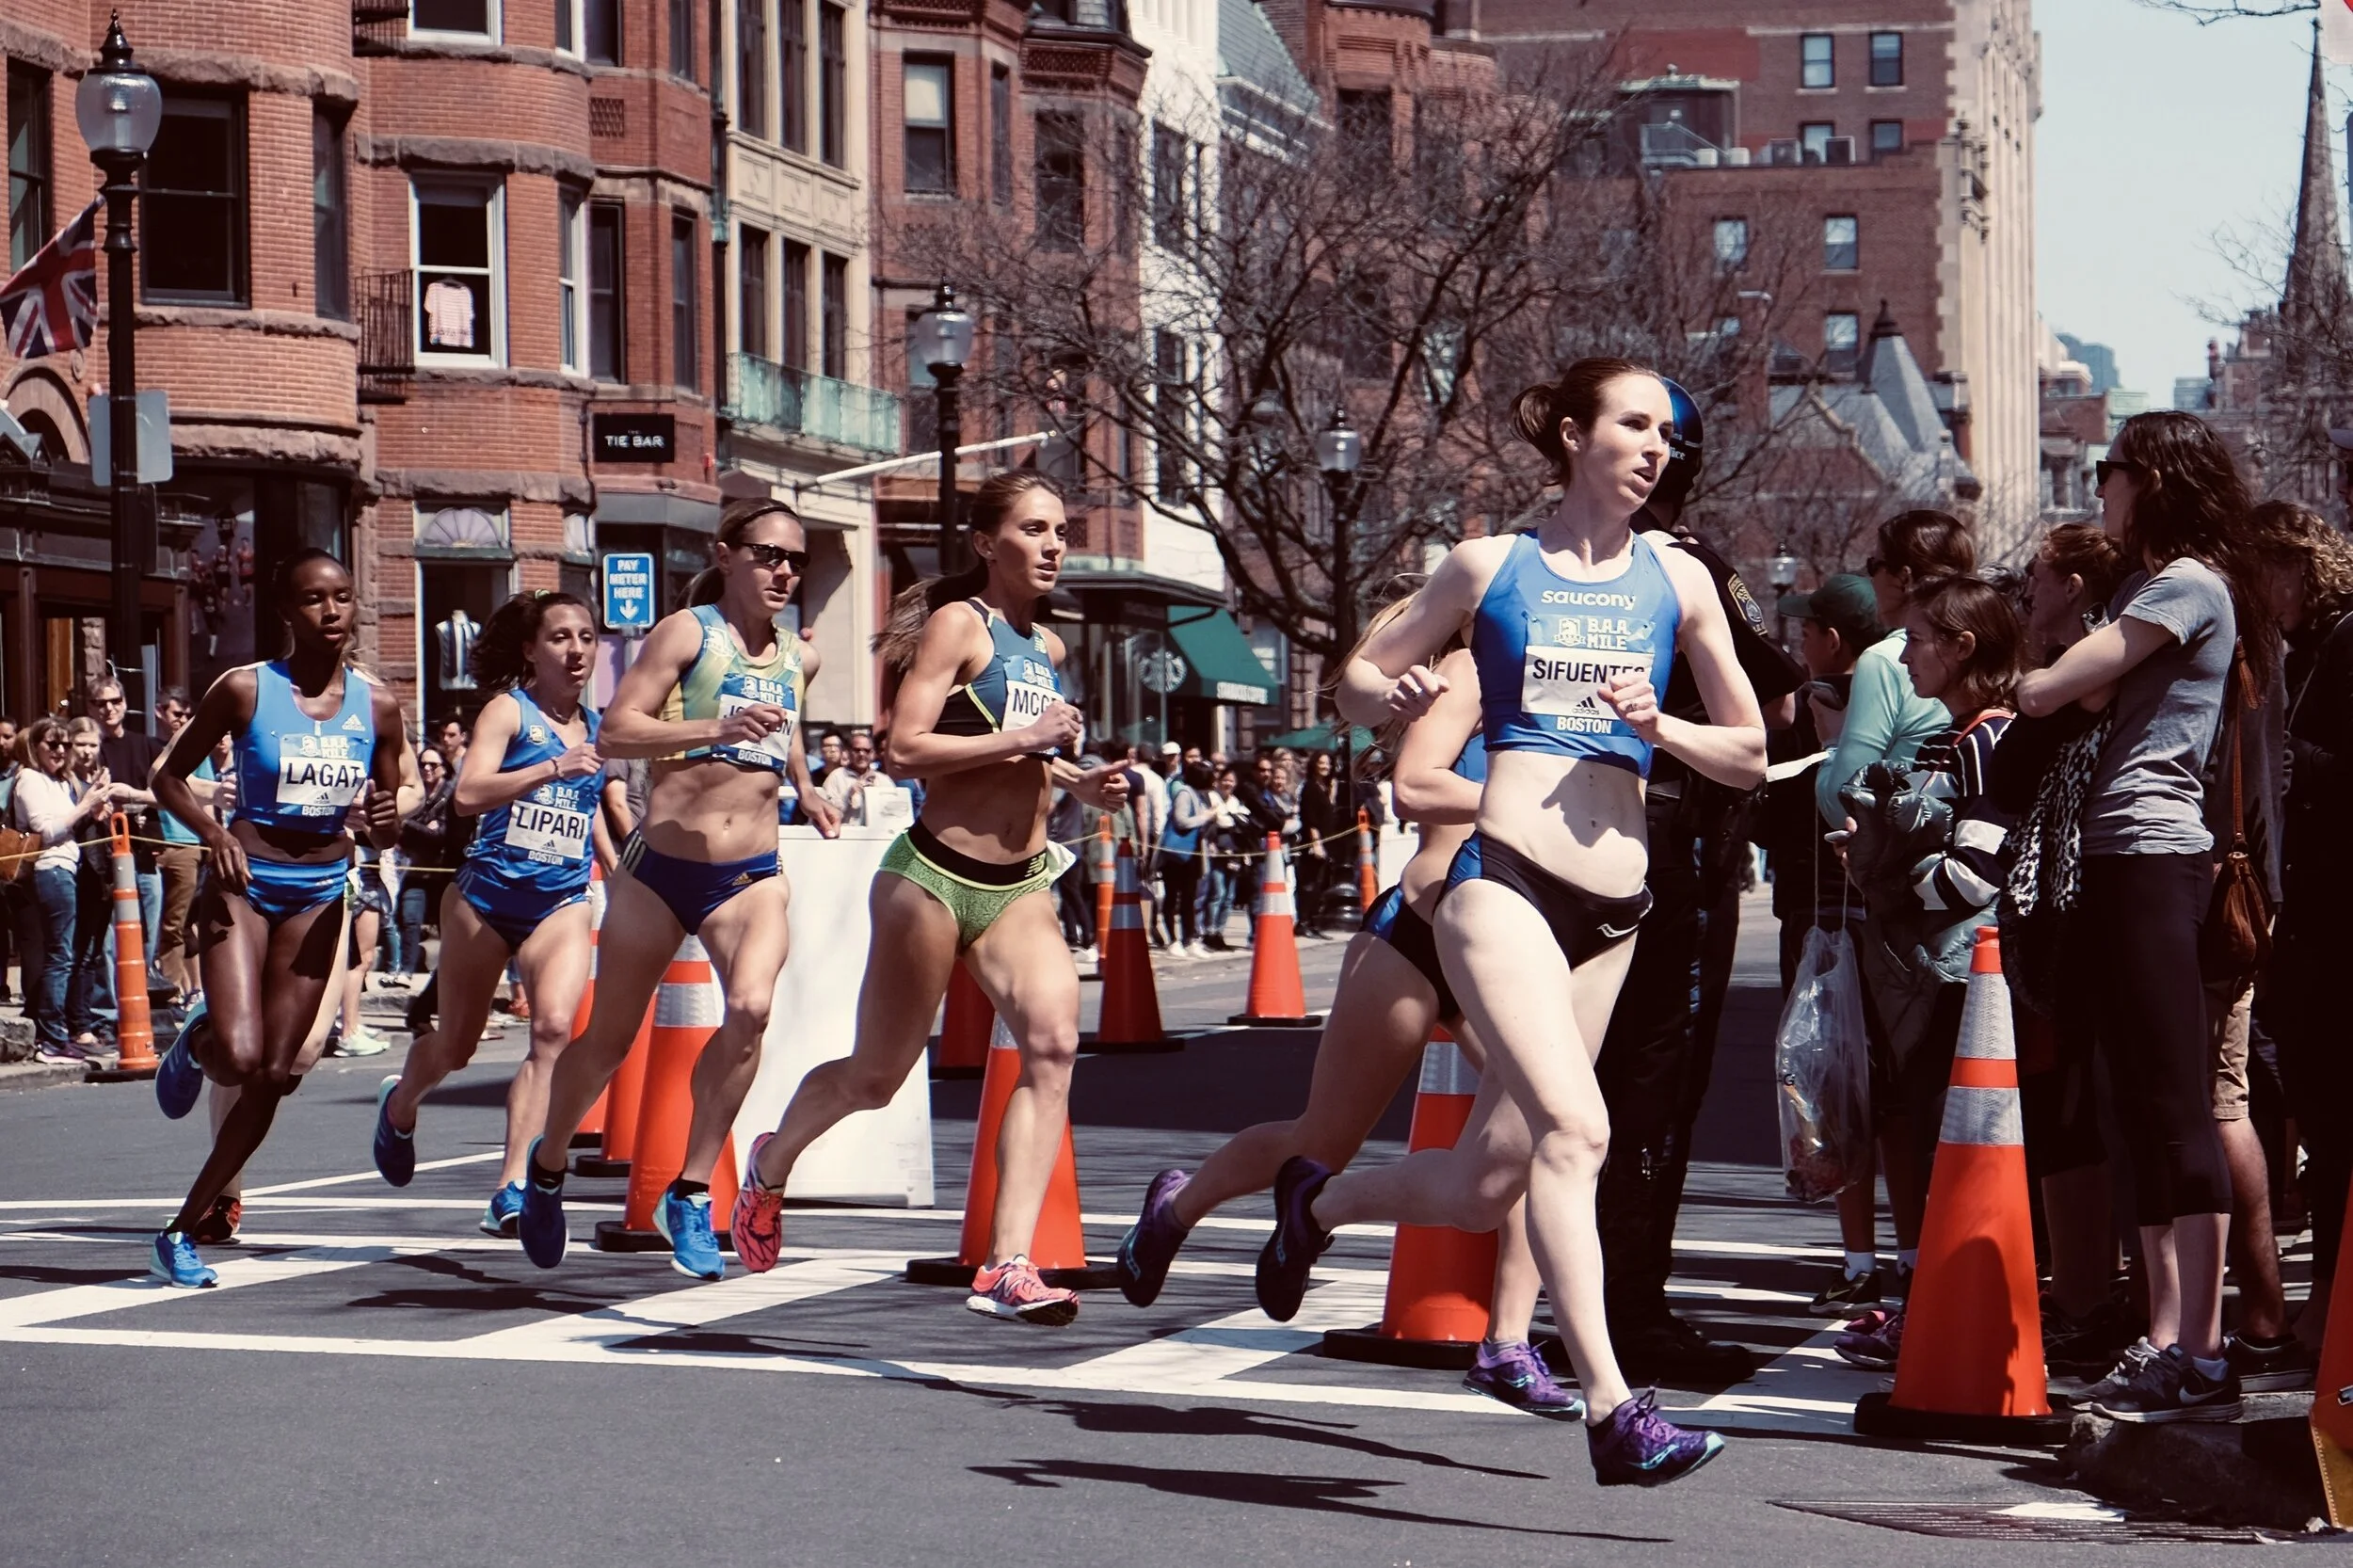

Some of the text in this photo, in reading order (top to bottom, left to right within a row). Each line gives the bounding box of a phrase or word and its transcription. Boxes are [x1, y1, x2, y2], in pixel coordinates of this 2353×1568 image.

[604, 435, 664, 448] TIE BAR
[617, 559, 640, 572] PAY
[609, 572, 648, 585] METER
[614, 586, 645, 600] HERE
[1541, 590, 1636, 611] saucony
[1586, 633, 1627, 650] MILE
[1557, 716, 1612, 734] BOSTON
[737, 750, 773, 766] BOSTON
[286, 762, 361, 788] LAGAT
[301, 806, 336, 817] BOSTON
[516, 806, 585, 840] LIPARI
[527, 850, 564, 865] BOSTON
